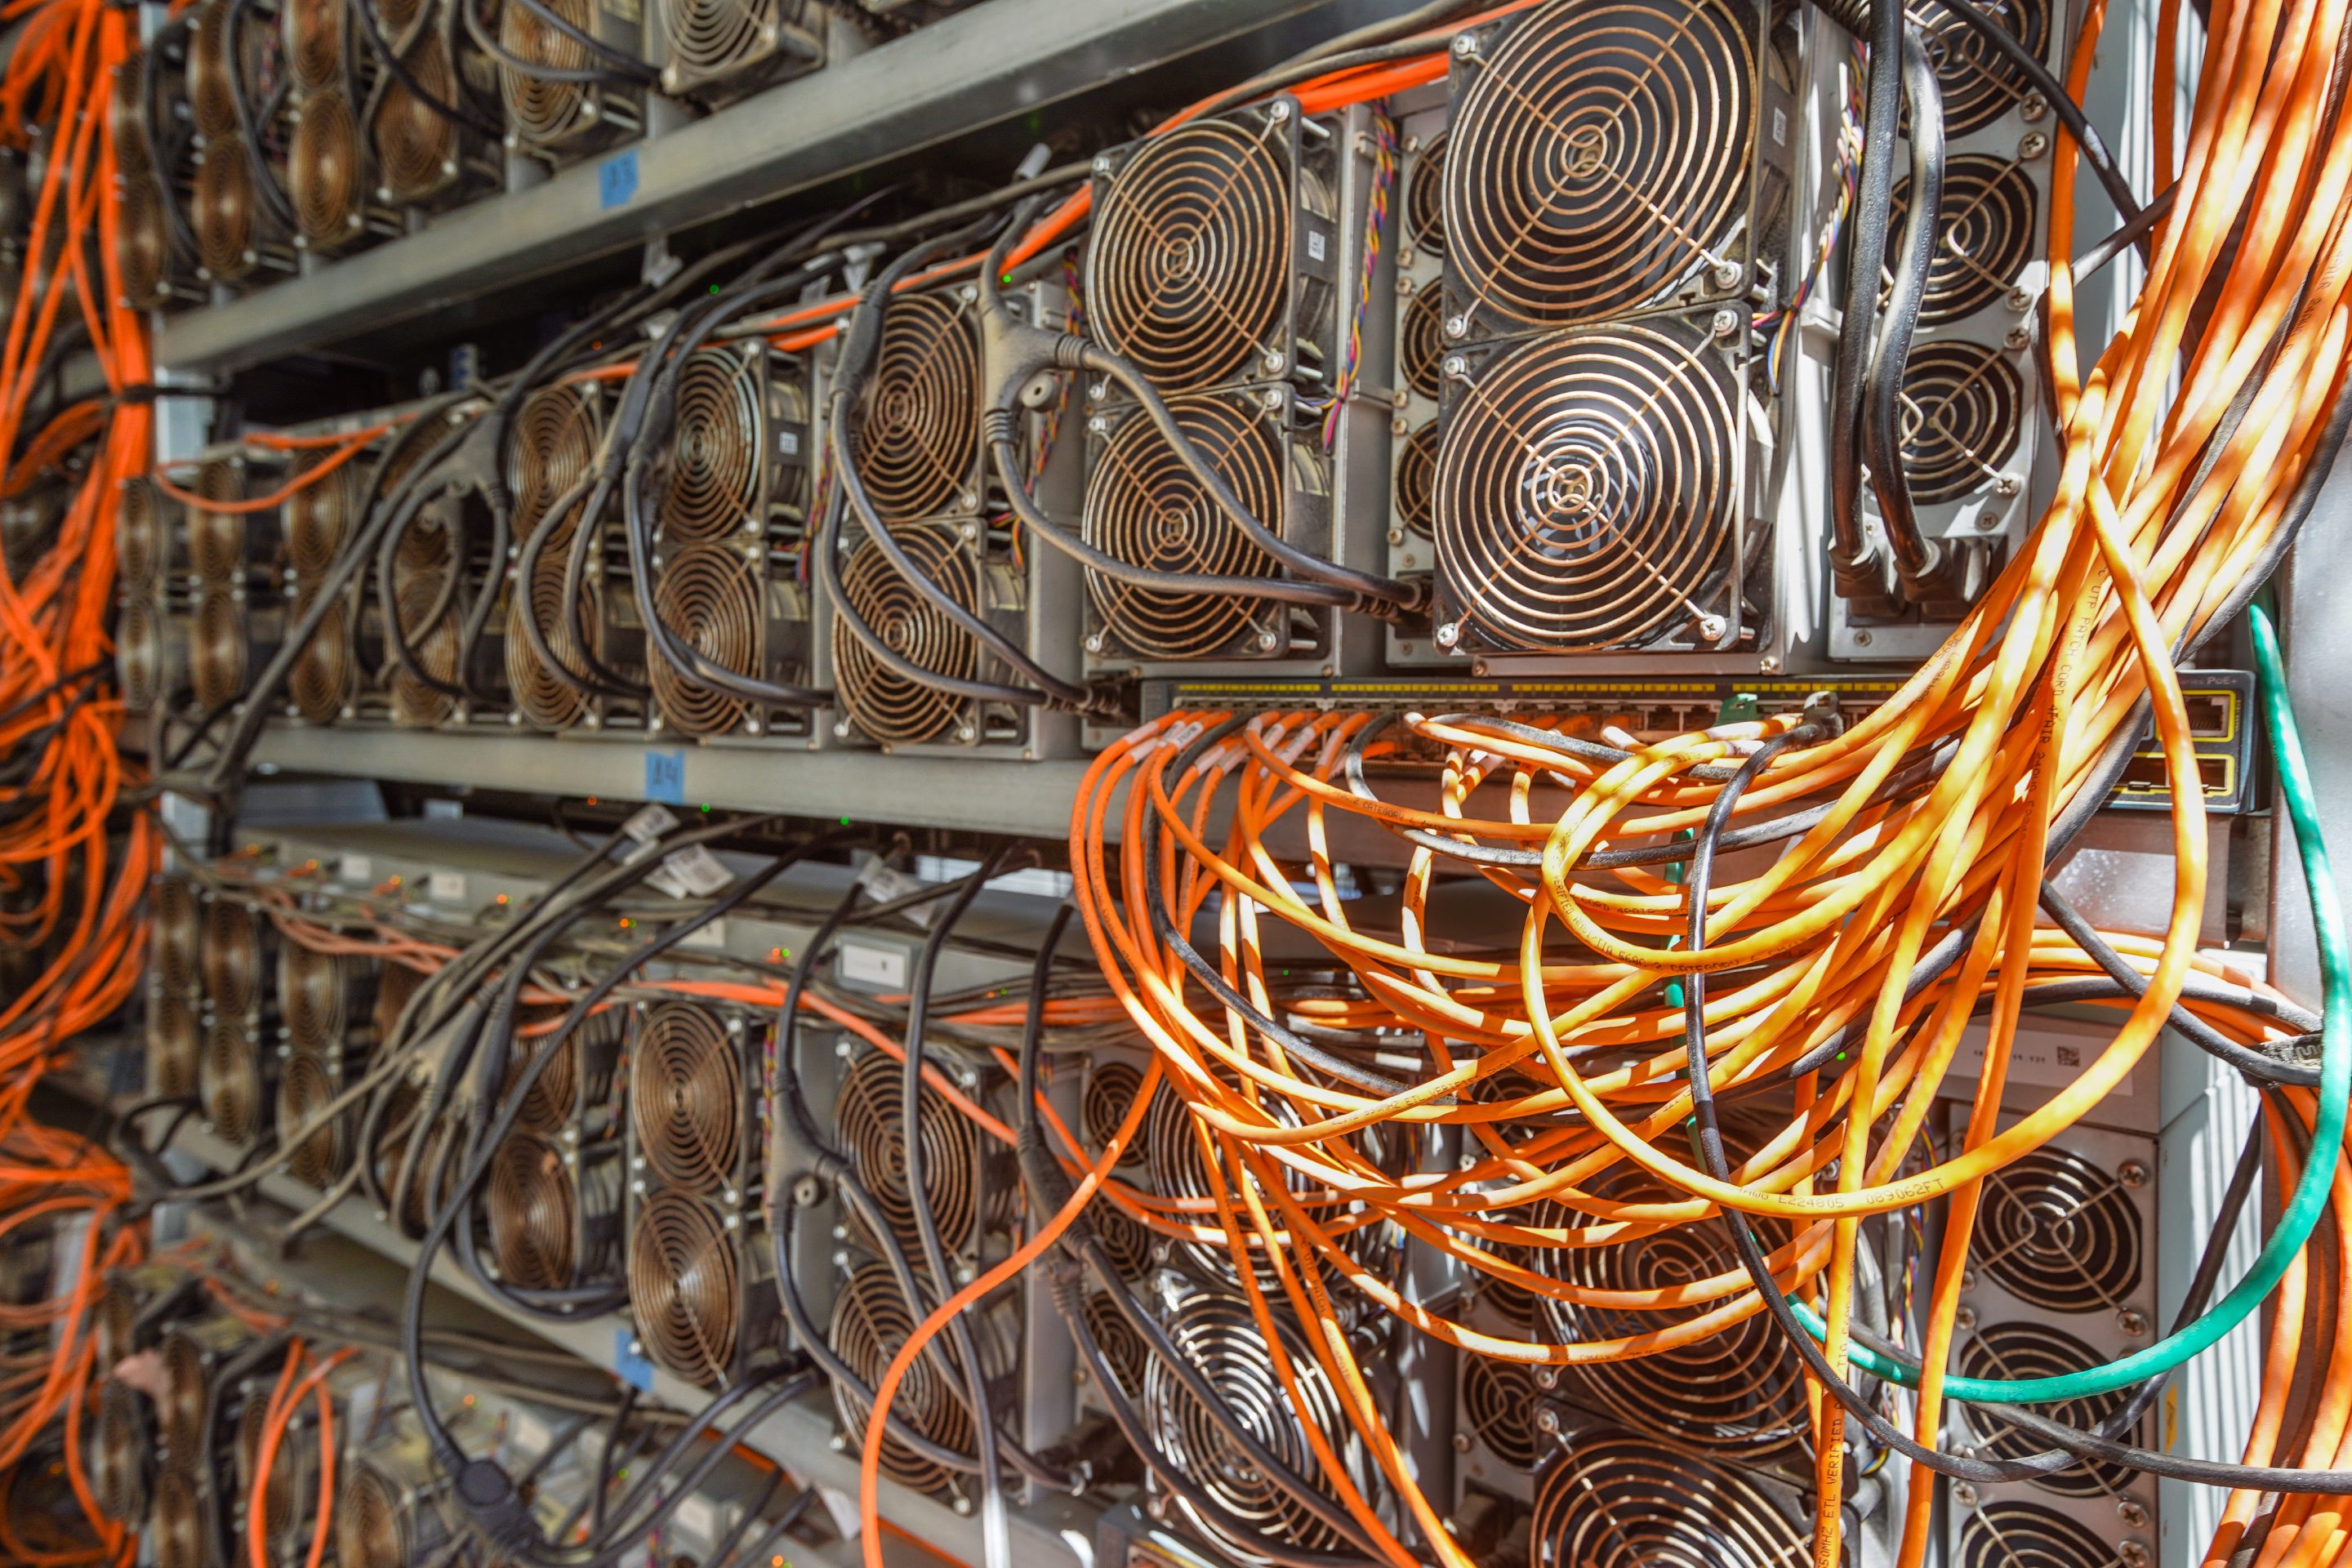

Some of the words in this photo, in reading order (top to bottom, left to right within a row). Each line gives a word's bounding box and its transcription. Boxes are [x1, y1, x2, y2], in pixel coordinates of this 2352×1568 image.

[2087, 584, 2102, 610] UTP
[2069, 617, 2091, 657] PATCH
[2052, 664, 2073, 697] CORD
[1362, 801, 1404, 820] CATEGORY
[1553, 875, 1574, 915] VERIFIED
[1778, 1194, 1845, 1209] E224805
[1865, 1178, 1946, 1206] 089062FT
[1825, 1419, 1844, 1486] VERIFIED
[1822, 1493, 1837, 1519] ETL
